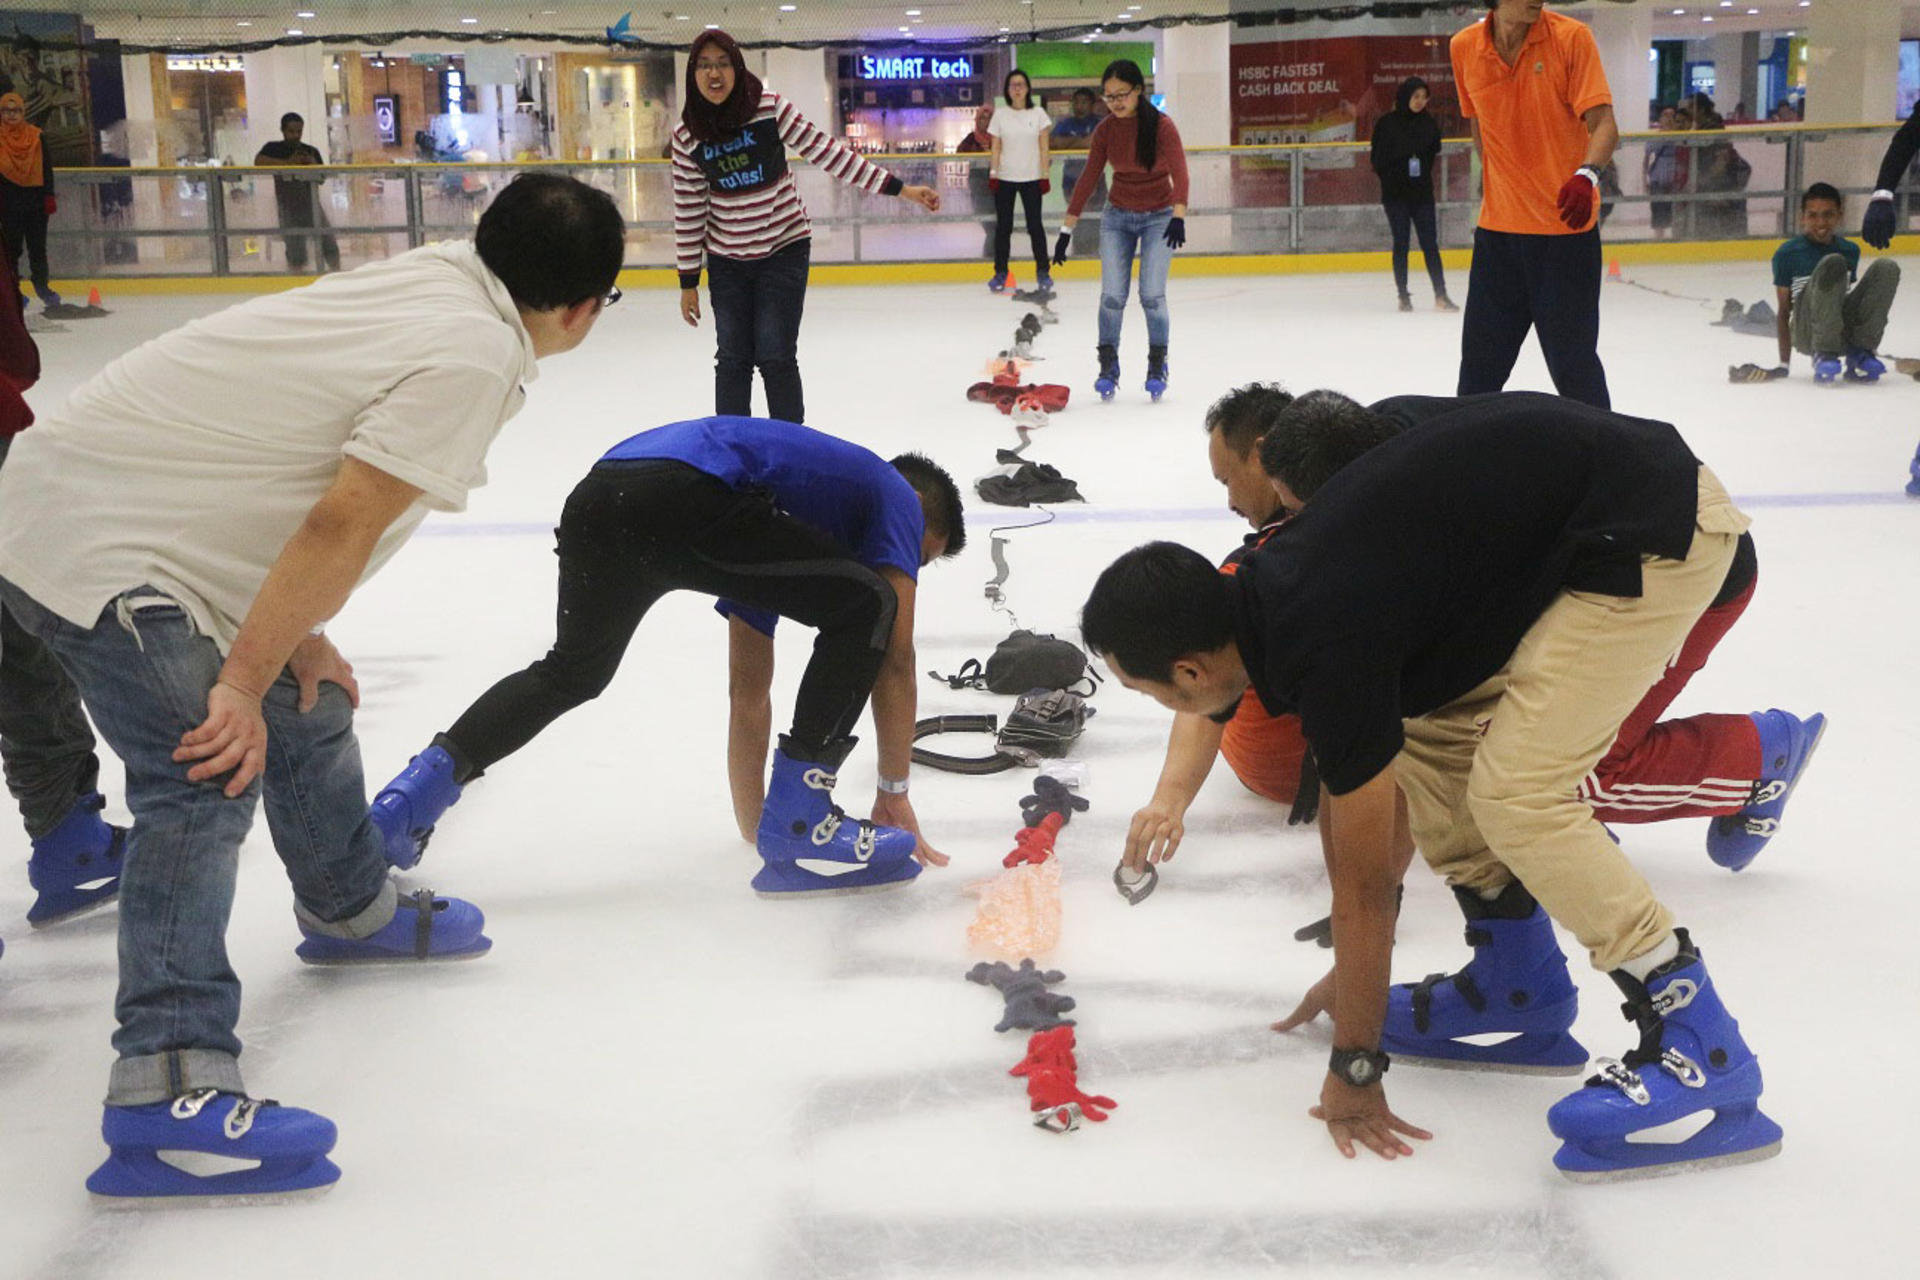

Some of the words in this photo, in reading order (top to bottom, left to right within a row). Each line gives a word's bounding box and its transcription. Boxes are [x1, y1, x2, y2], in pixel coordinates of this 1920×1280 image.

[863, 57, 924, 79] SMART
[931, 57, 970, 78] tech
[1239, 66, 1271, 80] HSBC
[1273, 63, 1325, 78] FASTEST
[1239, 83, 1271, 97] CASH
[1273, 81, 1305, 95] BACK
[1308, 79, 1340, 94] DEAL
[718, 153, 749, 172] the
[718, 163, 764, 188] rules!
